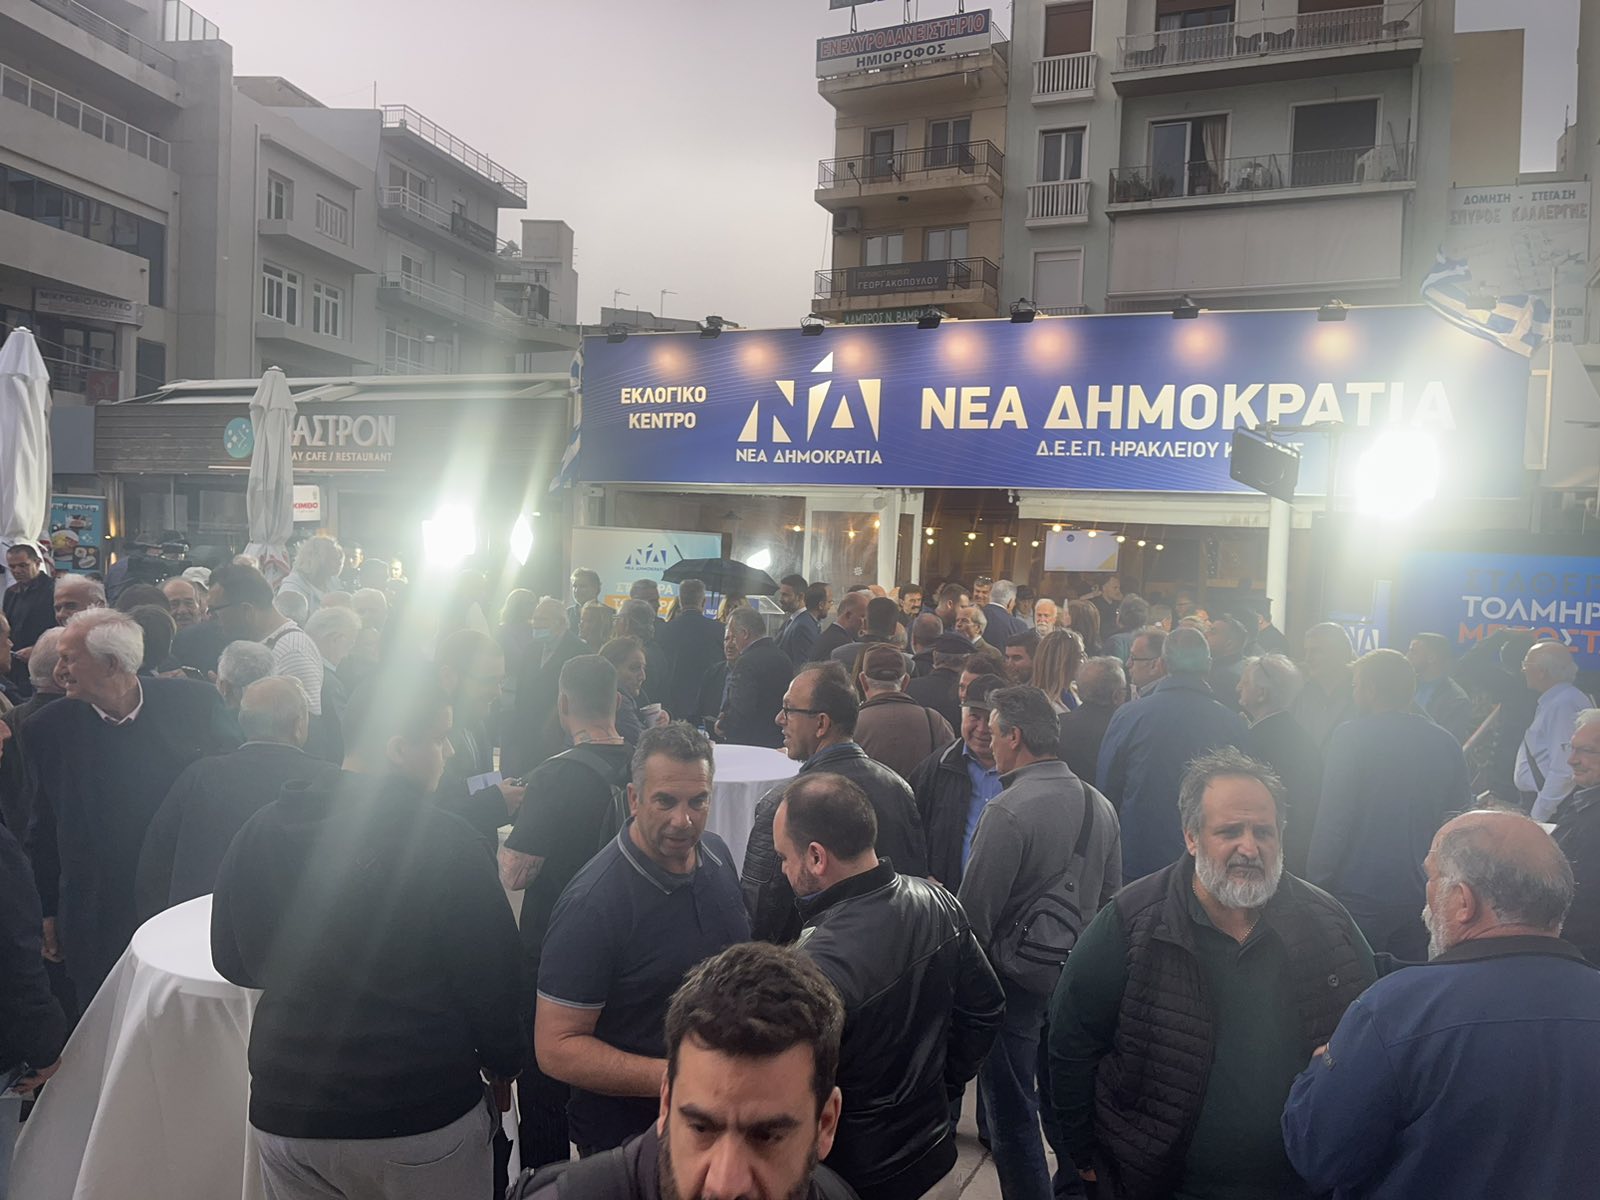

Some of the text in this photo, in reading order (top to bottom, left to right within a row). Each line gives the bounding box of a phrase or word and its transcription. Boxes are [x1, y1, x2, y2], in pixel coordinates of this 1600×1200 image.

[821, 13, 985, 57] ΕΝΕΧΥΡΟΔΑΝΕΙΣΤΗΡΙΟ
[856, 43, 946, 67] ΗΜΙΟΡΟΦΟΣ
[1463, 193, 1511, 205] ΔΟΜΗΣΗ
[1531, 190, 1576, 201] ΣΤΕΓΑΣΗ
[620, 386, 708, 404] ΕΚΛΟΓΙΚΟ
[920, 380, 1456, 430] ΝΕΑ ΔΗΜΟΚΡΑΤΙΑ
[628, 412, 697, 429] ΚΕΝΤΡΟ
[306, 452, 327, 461] CAFE
[336, 452, 392, 462] RESTAURANT
[736, 449, 882, 464] ΝΕΑ ΔΗΜΟΚΡΑΤΙΑ
[1111, 441, 1219, 458] ΗΡΑΚΛΕΙΟΥ
[1462, 595, 1600, 625] ΤΟΛΜΗΡ
